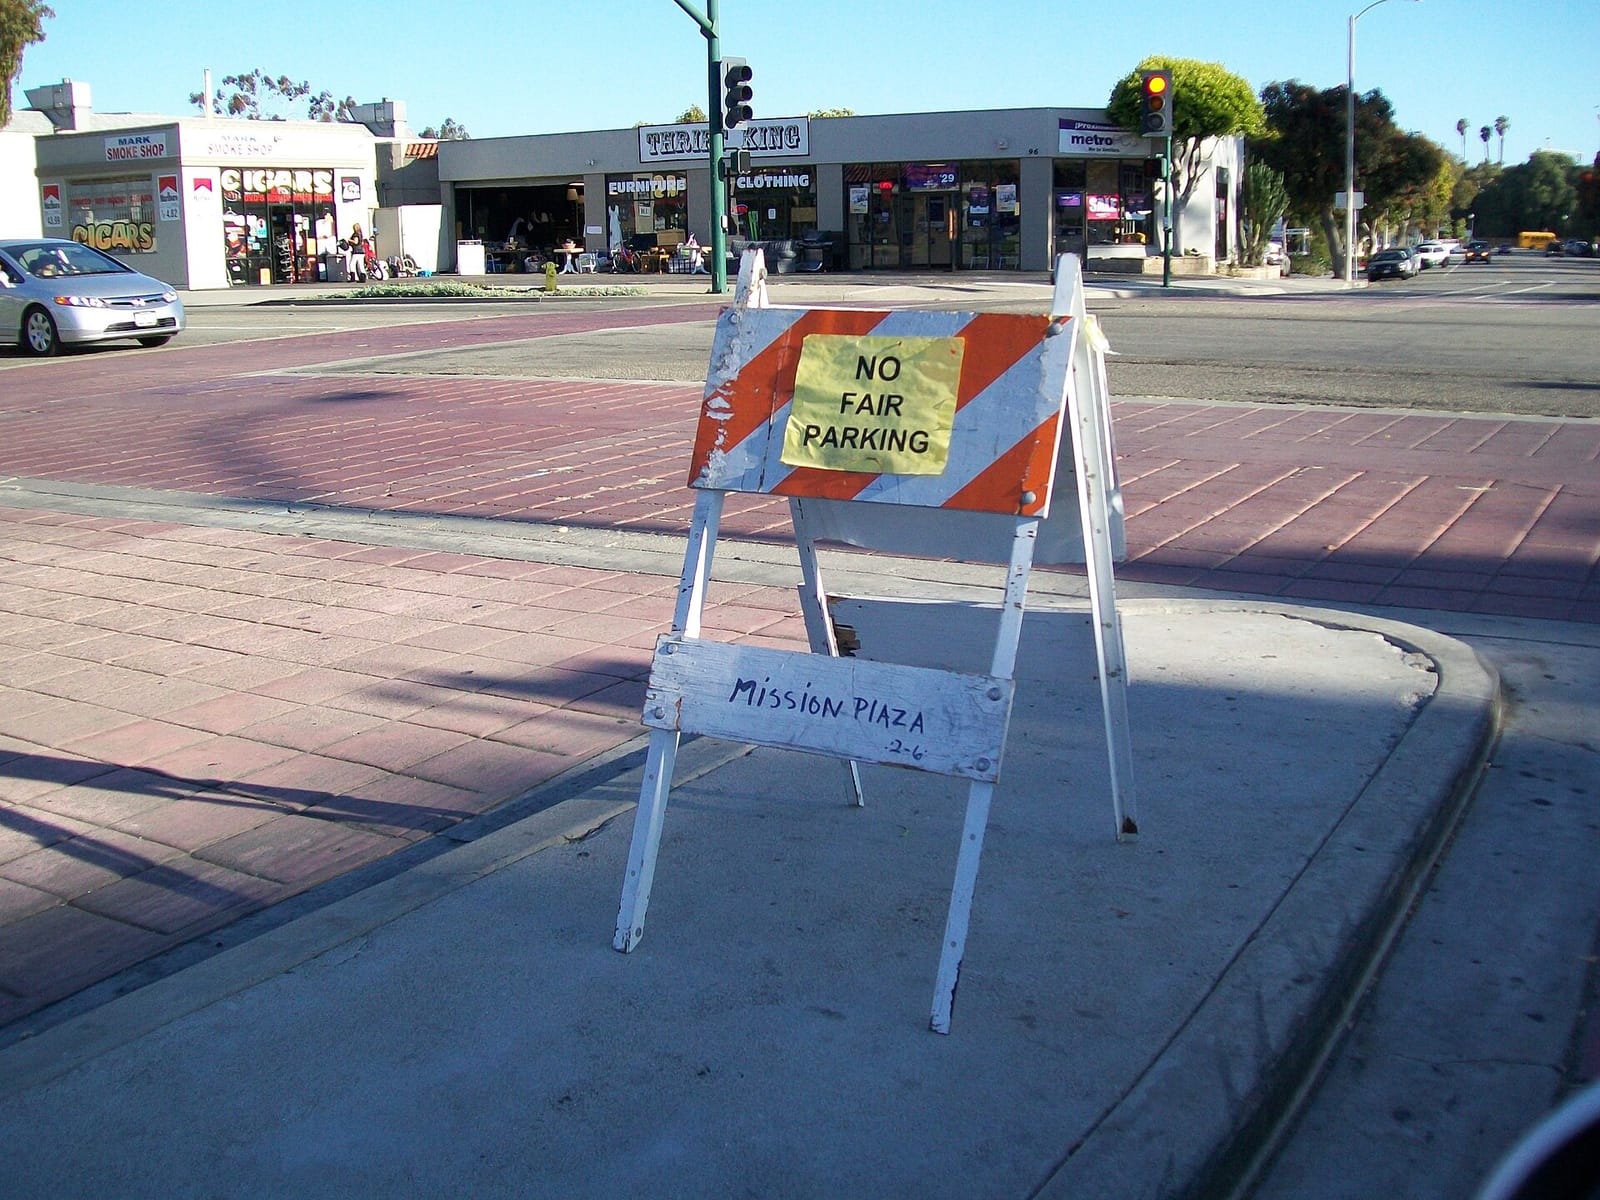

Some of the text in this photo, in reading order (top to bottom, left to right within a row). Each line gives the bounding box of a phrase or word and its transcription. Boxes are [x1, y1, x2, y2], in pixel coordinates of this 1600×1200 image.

[118, 136, 151, 145] MARK
[208, 143, 243, 155] SMOKE
[742, 125, 800, 150] KING
[107, 144, 165, 160] SMOKE SHOP
[221, 169, 333, 195] CIGARS
[609, 179, 686, 193] FURNITURE
[736, 174, 810, 189] CLOTHING
[72, 222, 153, 250] CIGARS
[855, 356, 901, 381] NO
[840, 393, 904, 416] FAIR
[803, 425, 929, 454] PARKING
